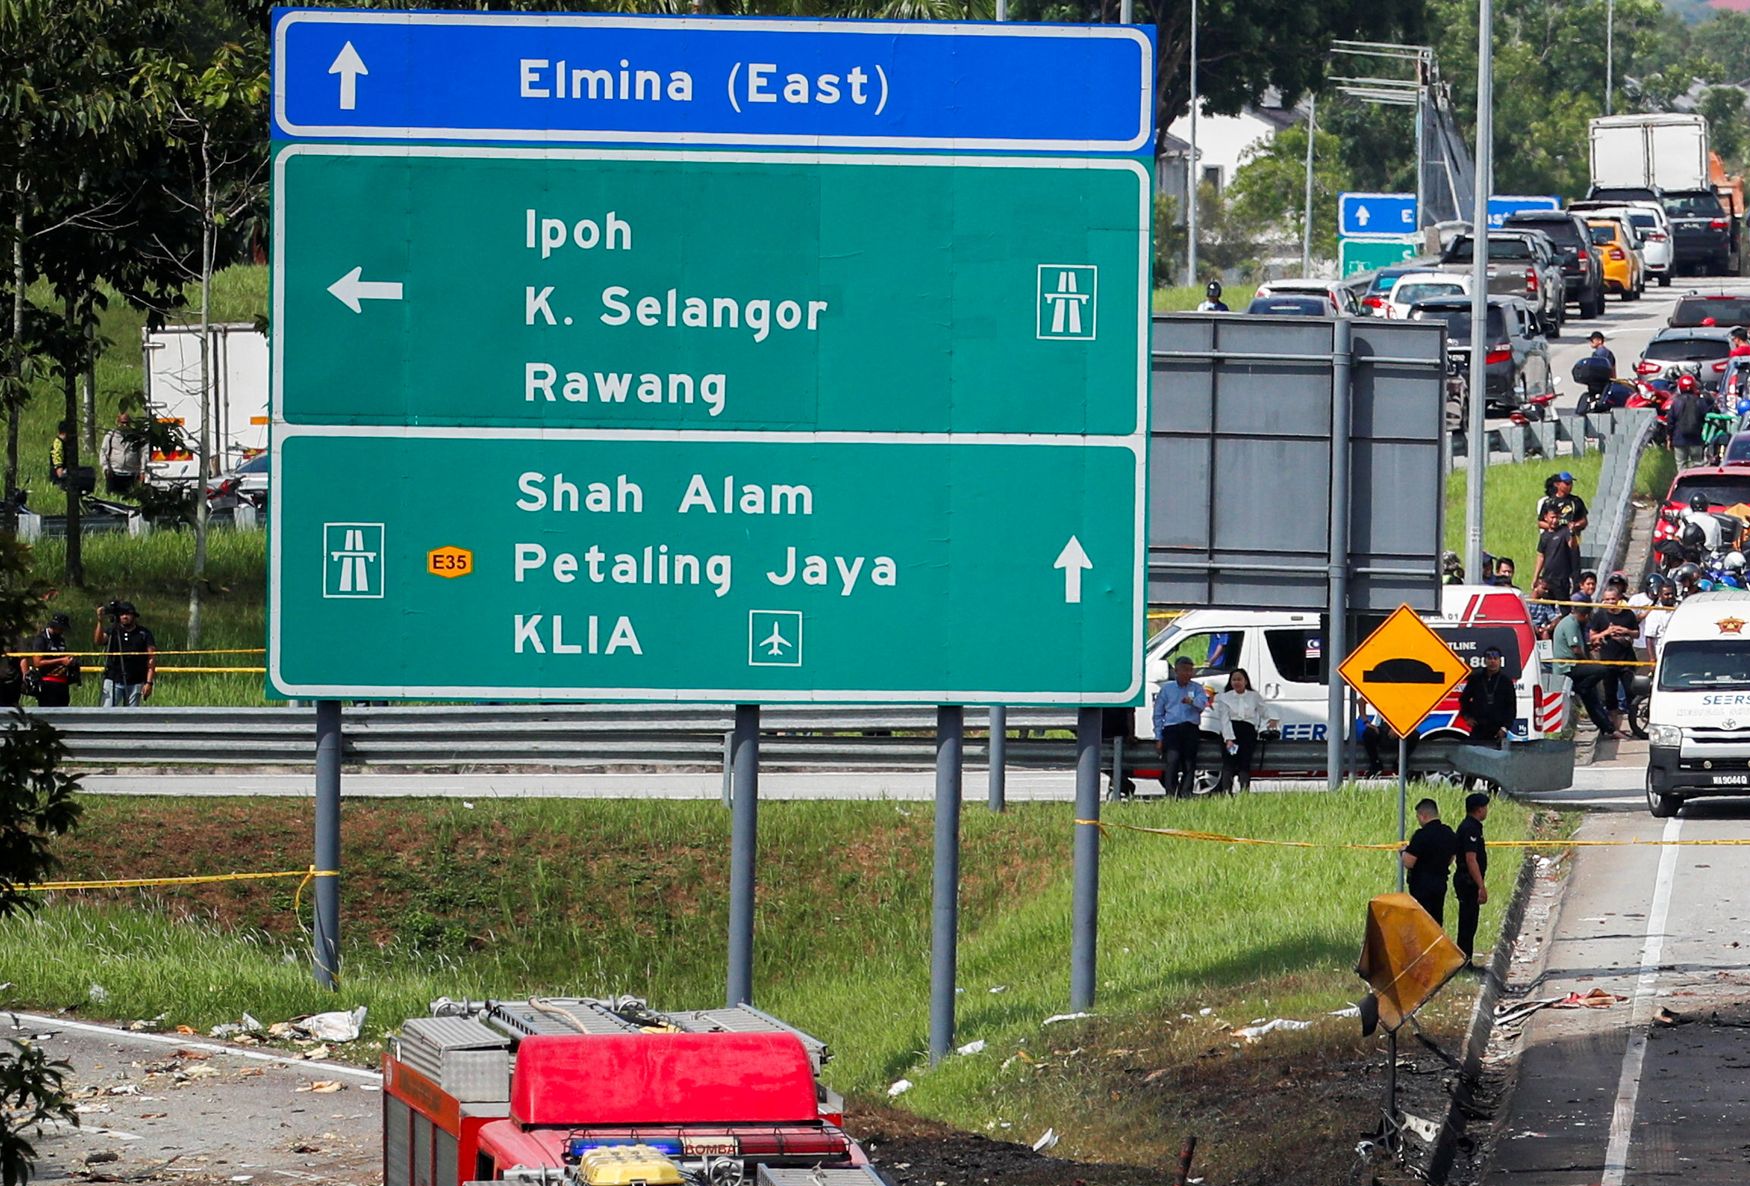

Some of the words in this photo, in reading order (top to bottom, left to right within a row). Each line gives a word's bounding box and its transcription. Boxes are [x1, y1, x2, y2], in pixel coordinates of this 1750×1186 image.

[520, 58, 693, 102] Elmina
[727, 62, 889, 116] (East)
[526, 208, 632, 260] Ipoh
[525, 286, 574, 326] K.
[600, 285, 828, 343] Selangor
[525, 362, 726, 417] Rawang
[515, 472, 644, 513] Shah
[678, 473, 813, 515] Alam
[432, 554, 467, 571] E35
[514, 543, 732, 598] Petaling
[766, 546, 897, 596] Jaya
[513, 614, 644, 656] KLIA
[684, 1143, 735, 1156] BOMBA
